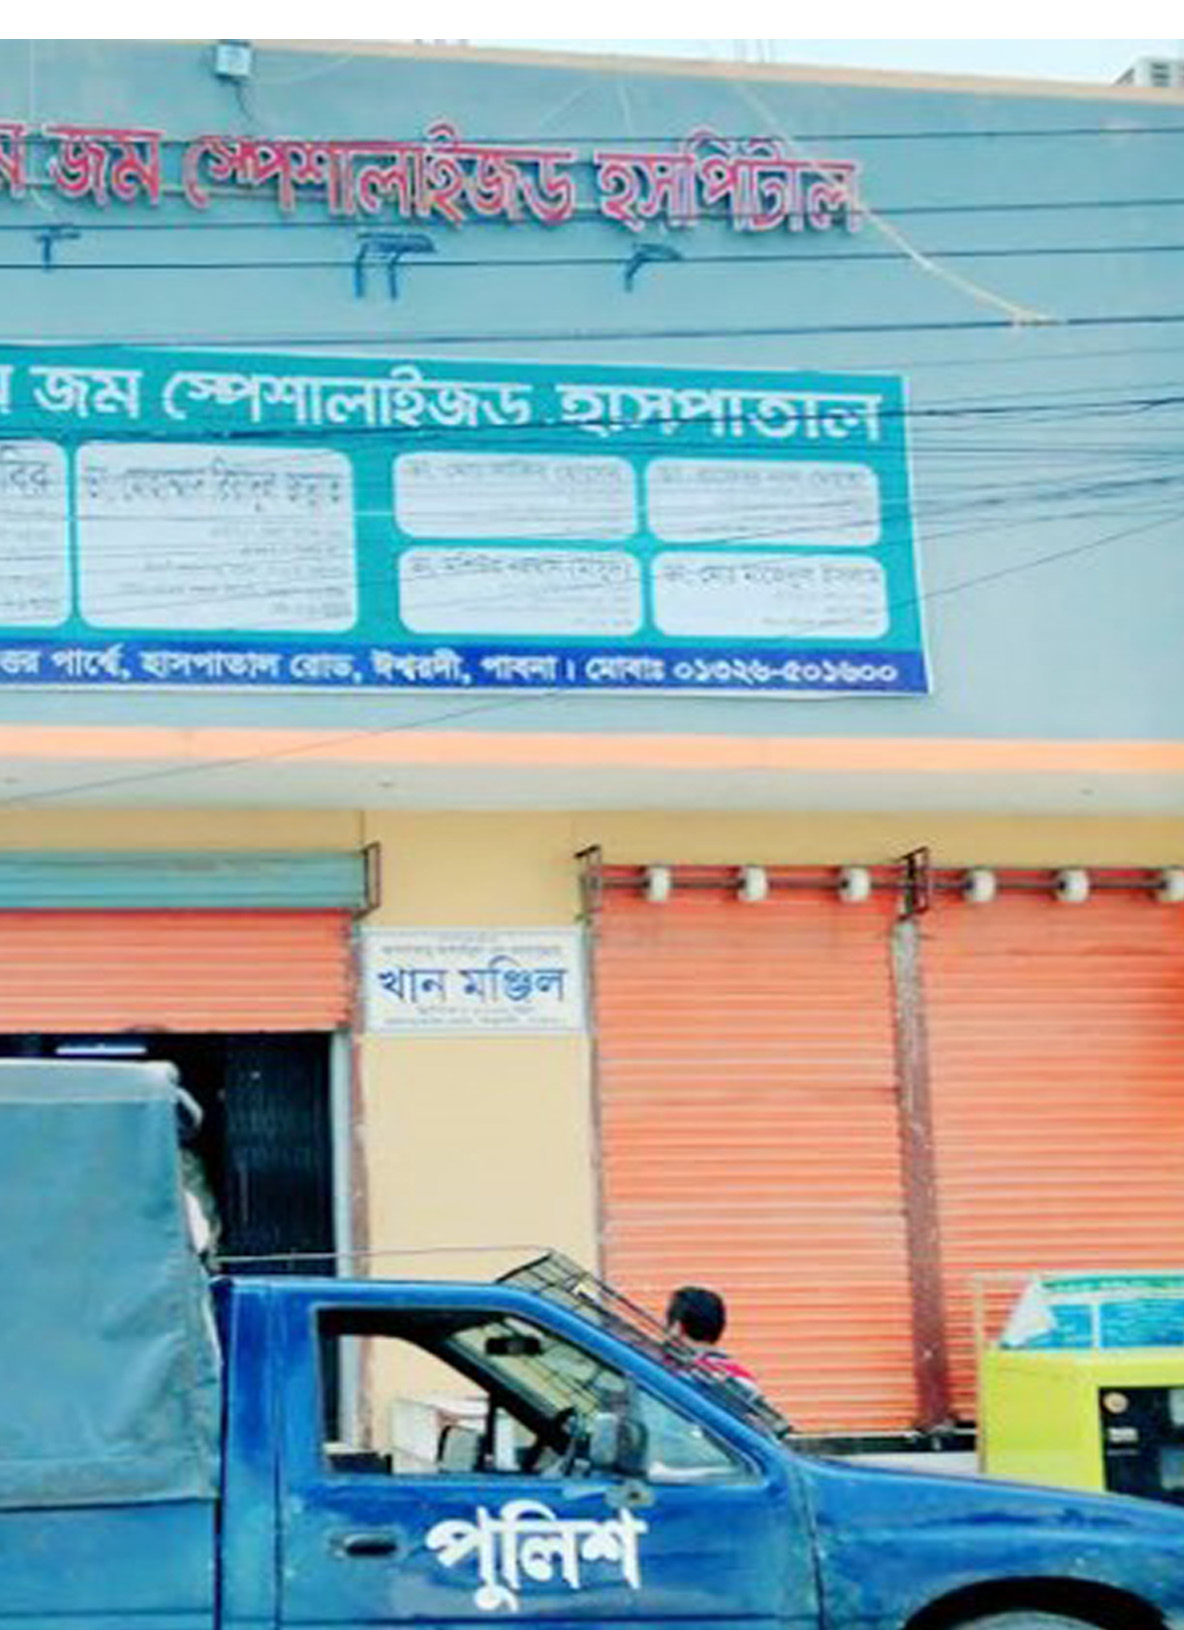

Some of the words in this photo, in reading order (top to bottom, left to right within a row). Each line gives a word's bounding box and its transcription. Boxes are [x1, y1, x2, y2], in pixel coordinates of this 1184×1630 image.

[42, 121, 165, 207] জম
[182, 117, 578, 228] স্পেশালাইজড
[28, 365, 144, 420] জম
[161, 364, 533, 428] স্পেশালাইজড
[554, 383, 883, 442] হাসপাতাল
[139, 648, 281, 679] হাসপাতাল
[377, 964, 448, 1004] খান
[425, 1498, 649, 1612] পুলিশ
